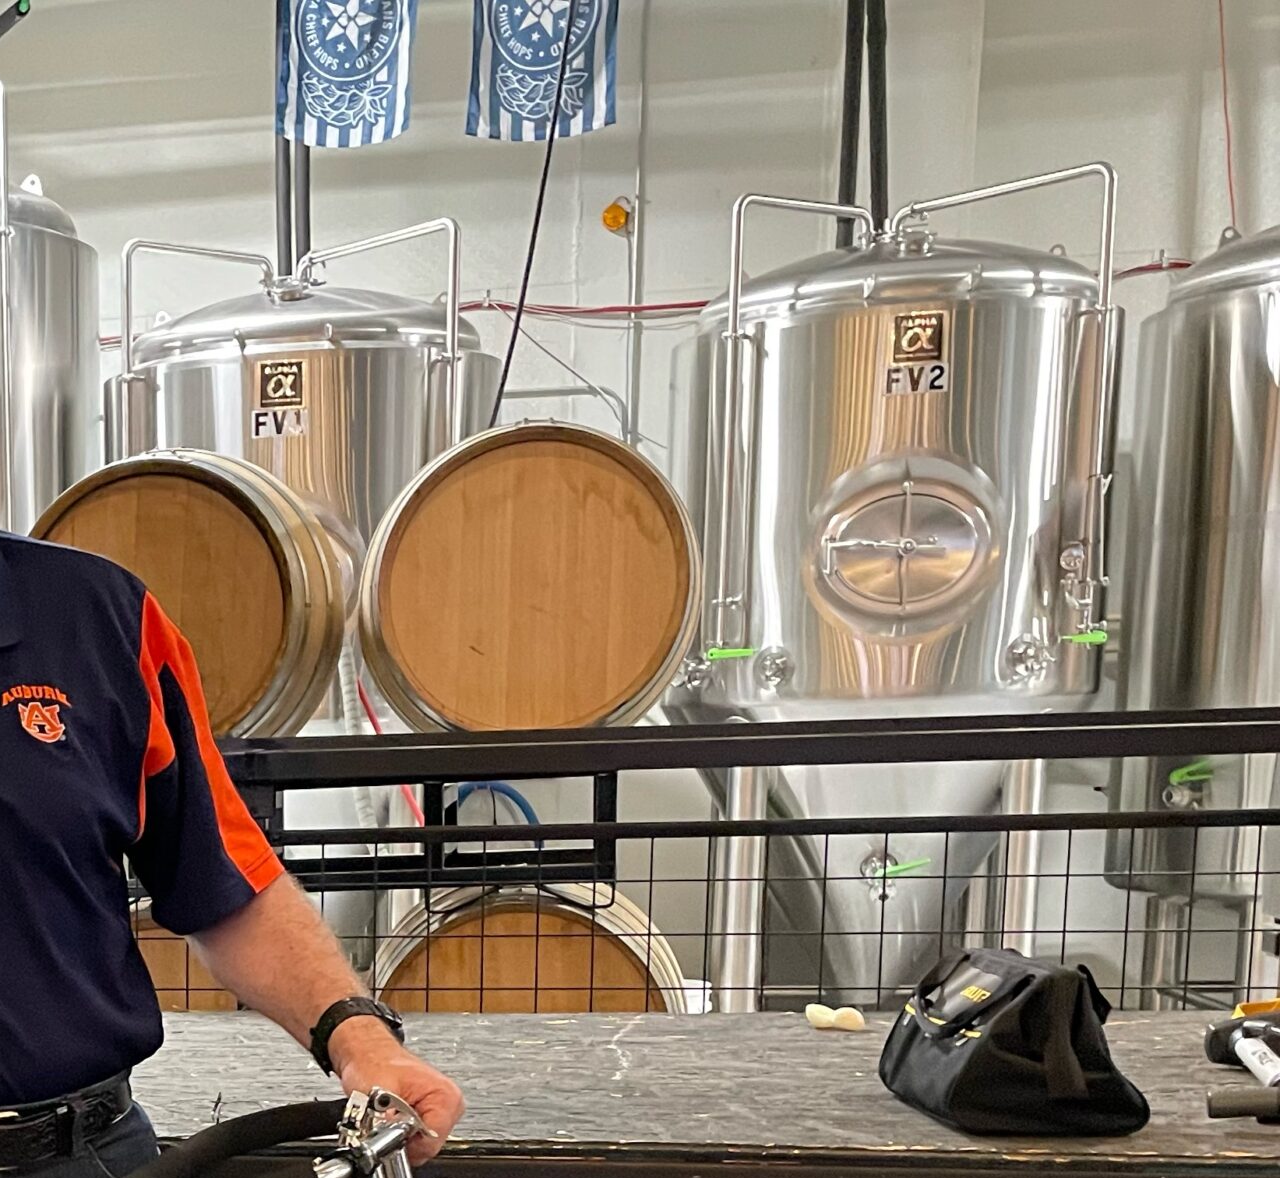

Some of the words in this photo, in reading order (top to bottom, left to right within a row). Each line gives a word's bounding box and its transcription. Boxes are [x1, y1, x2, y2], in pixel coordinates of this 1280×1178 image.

[306, 13, 320, 47] CHIEF
[313, 46, 340, 71] HOPS
[499, 4, 513, 38] CHIEF
[507, 37, 534, 60] HOPS
[550, 18, 587, 57] BLED
[355, 34, 390, 69] BLEND
[886, 364, 945, 394] FV2
[2, 684, 72, 708] AUBURN
